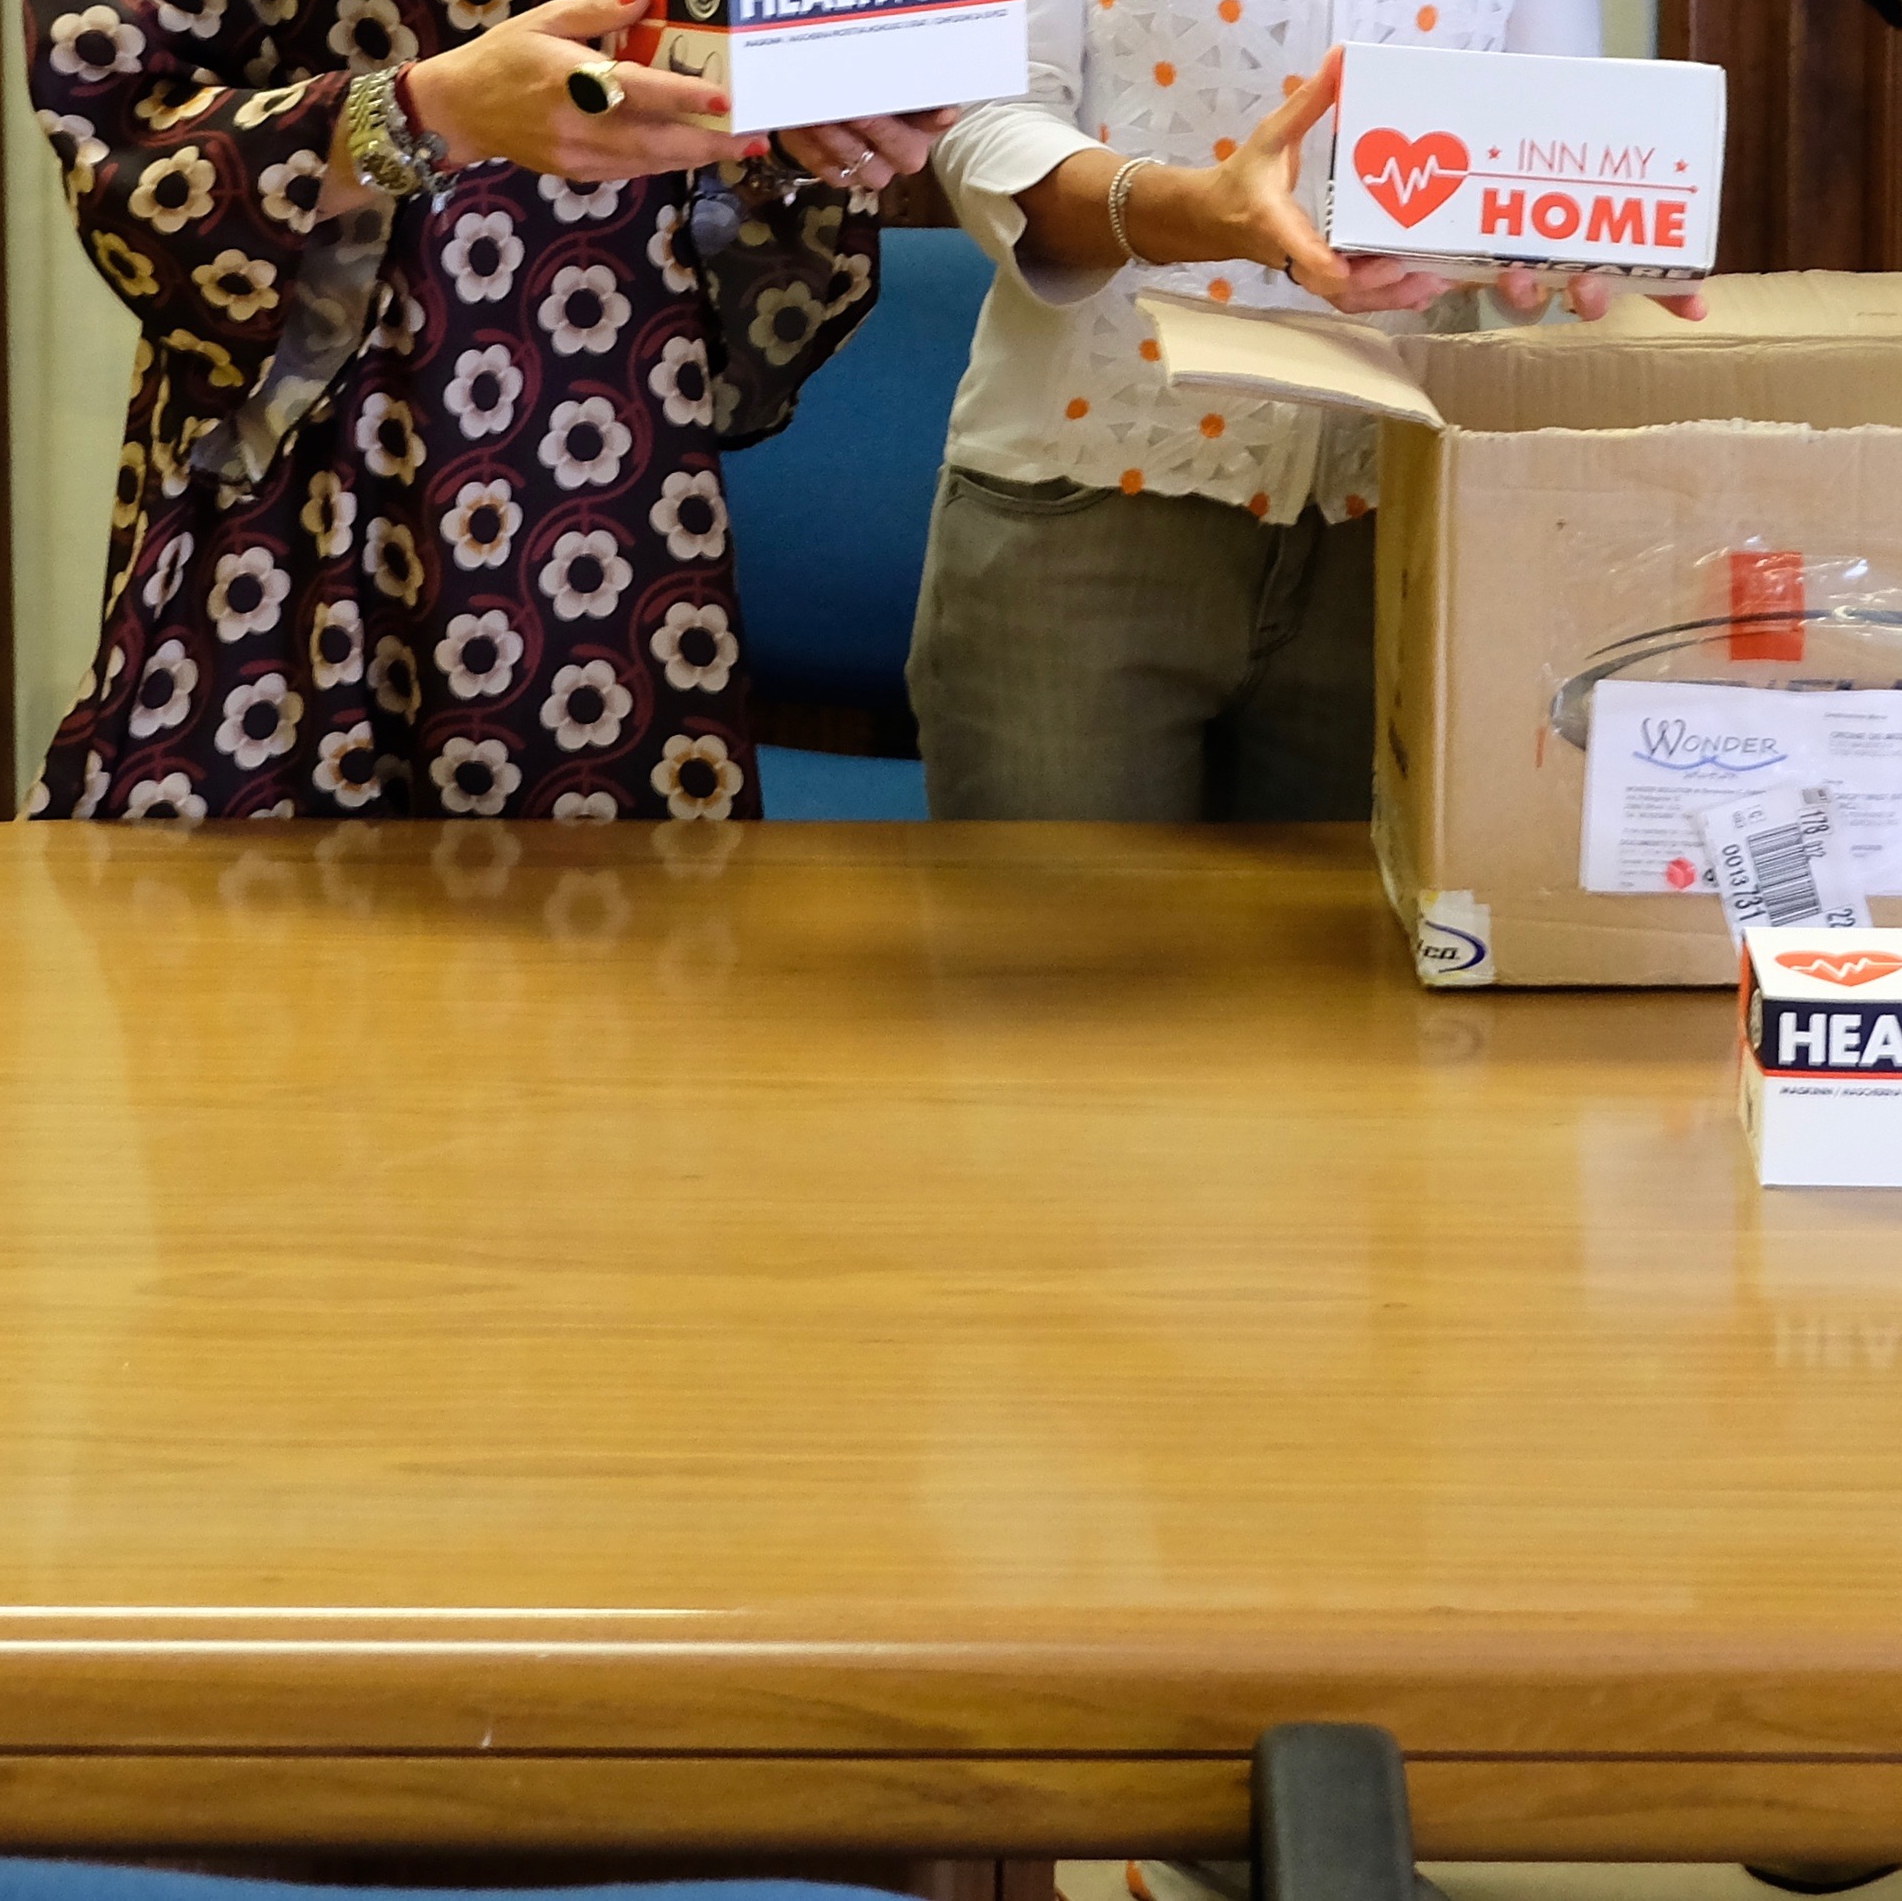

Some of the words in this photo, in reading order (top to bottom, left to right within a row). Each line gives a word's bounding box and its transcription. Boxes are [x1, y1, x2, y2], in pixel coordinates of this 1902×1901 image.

[1517, 138, 1588, 174] INN
[1599, 146, 1656, 179] MY
[1479, 186, 1689, 249] HOME
[1640, 716, 1780, 758] WONDER
